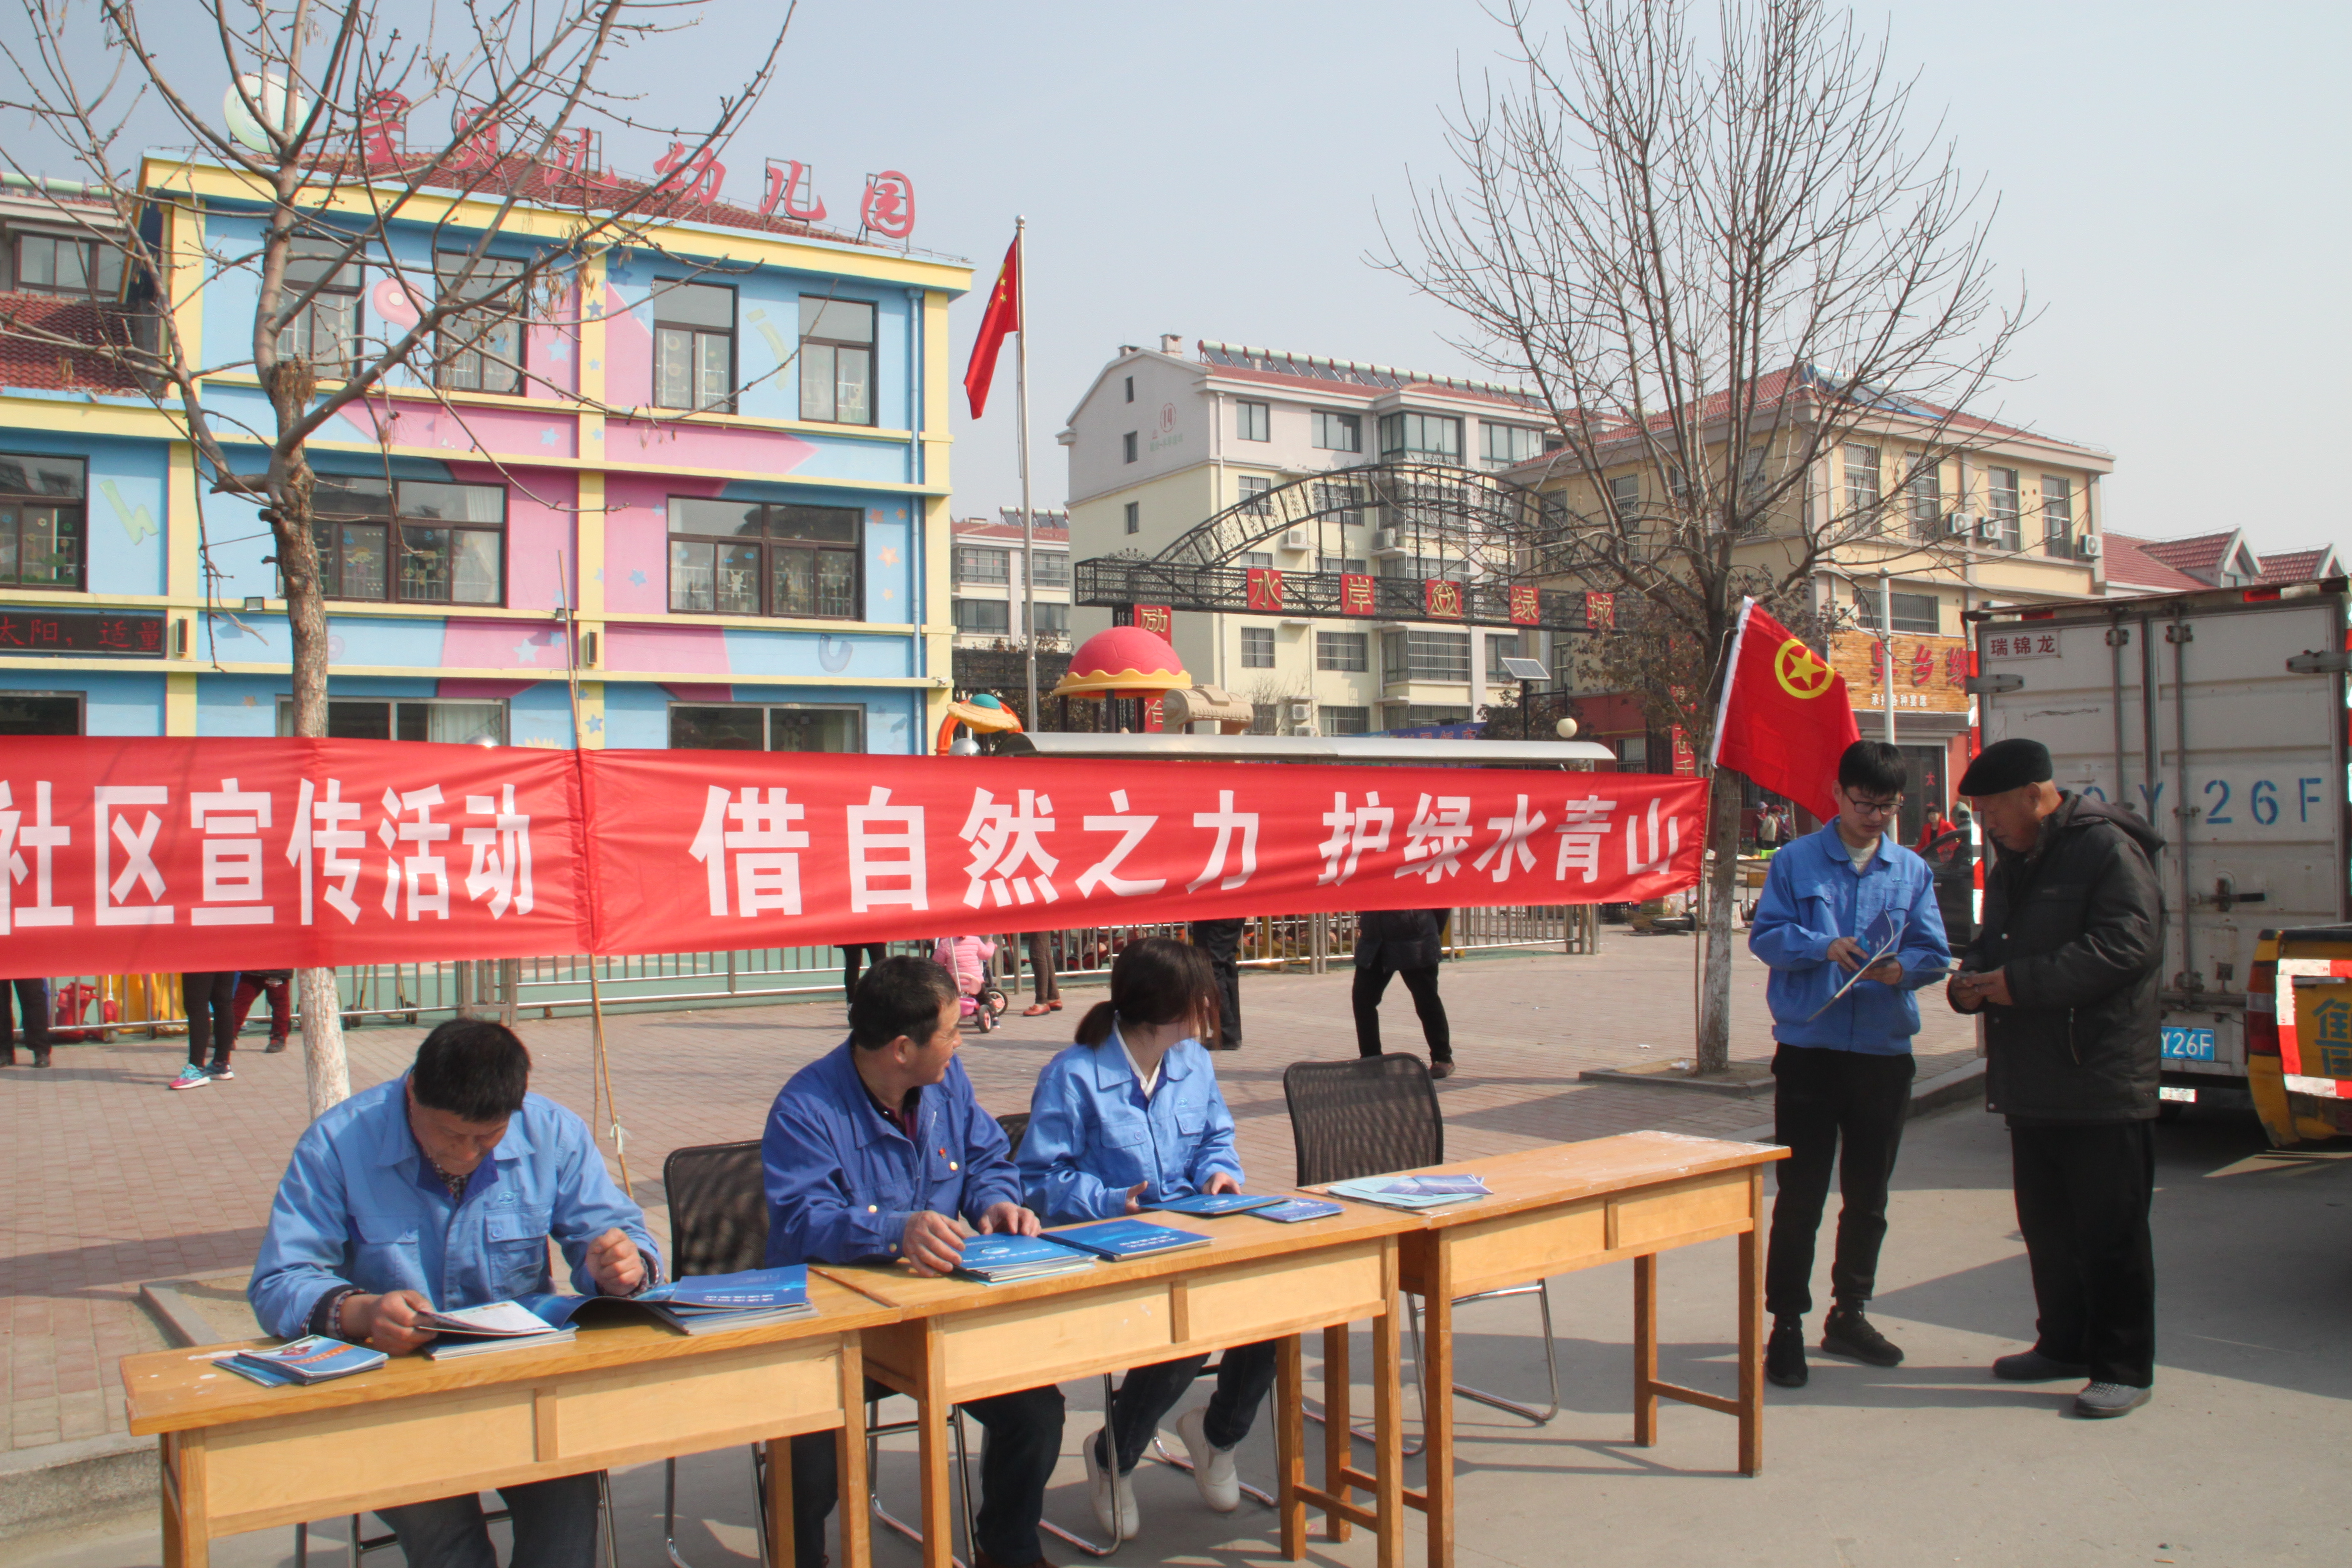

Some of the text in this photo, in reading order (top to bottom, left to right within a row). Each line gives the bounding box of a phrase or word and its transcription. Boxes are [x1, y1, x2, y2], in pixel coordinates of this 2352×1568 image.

[1990, 635, 2056, 656] 瑞锦龙
[0, 778, 535, 935] 社区宣传活动
[688, 784, 1679, 917] 借自然之力 护绿水青山
